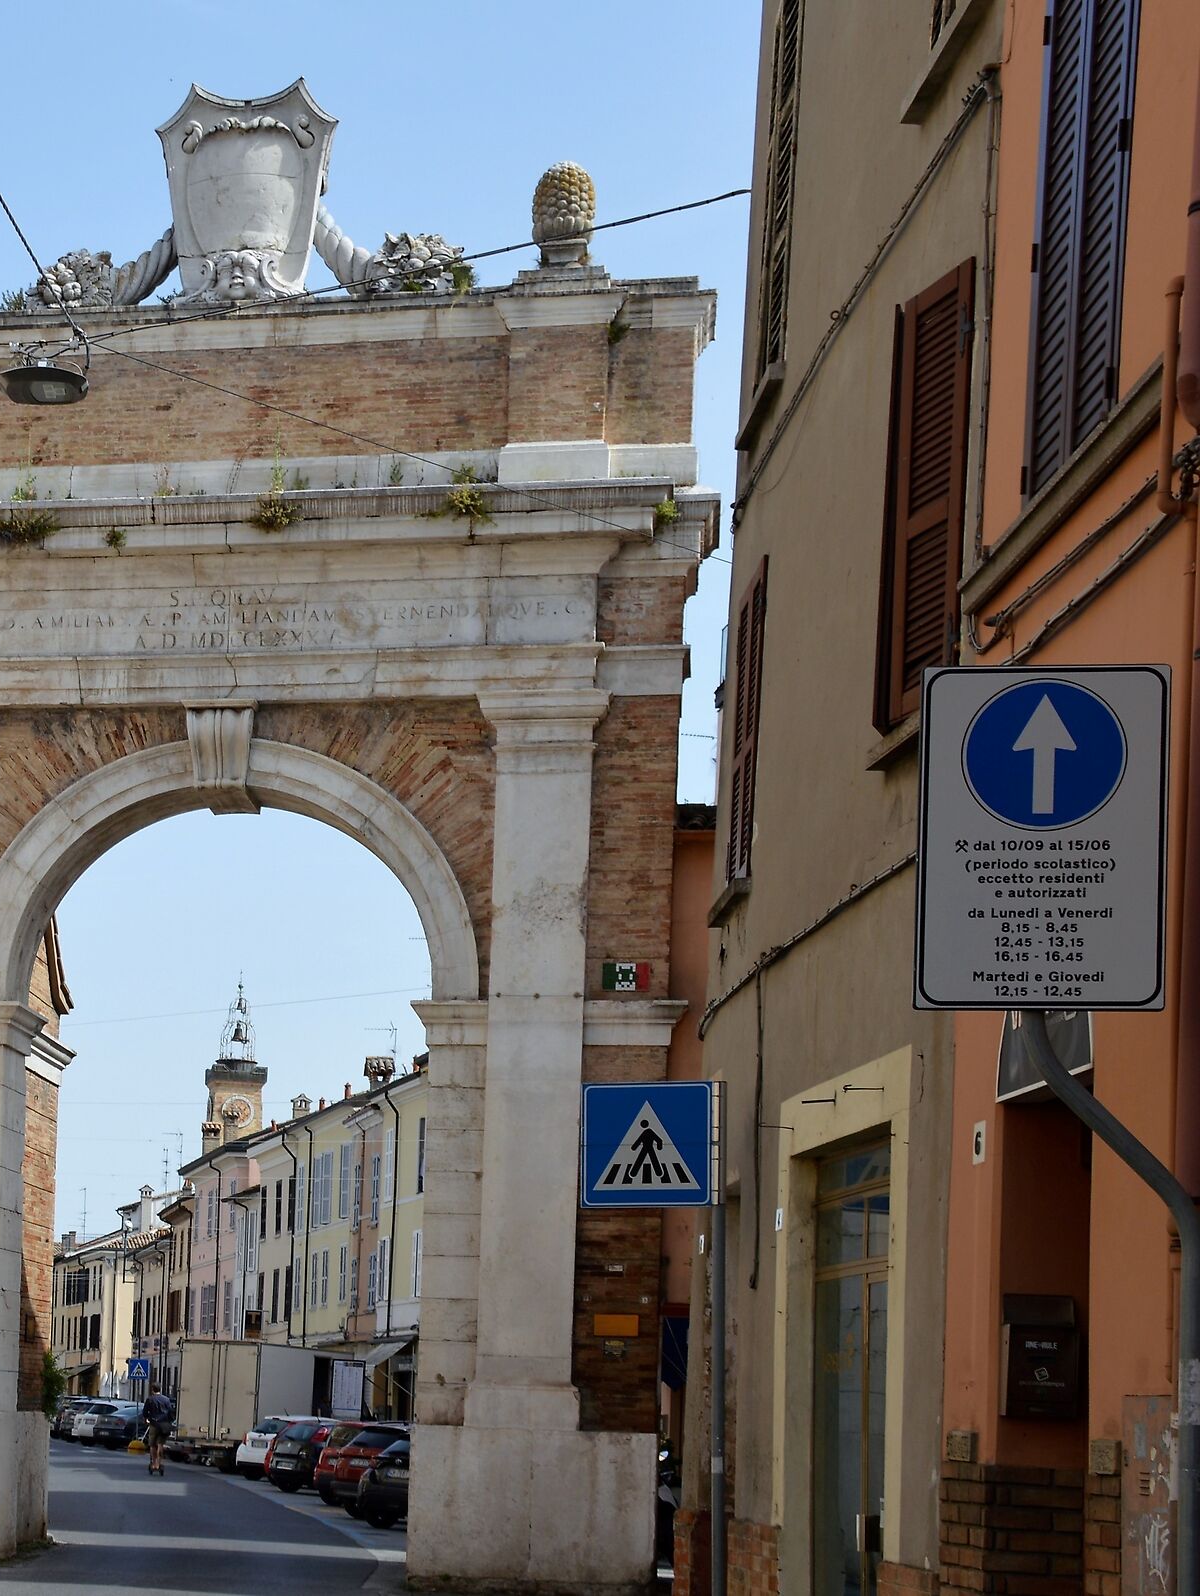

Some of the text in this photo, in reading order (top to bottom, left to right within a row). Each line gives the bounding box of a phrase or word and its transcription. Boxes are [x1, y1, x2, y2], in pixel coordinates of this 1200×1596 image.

[974, 840, 1110, 851] dal 10/09 al 15/06
[965, 858, 1116, 872] (periodo scolastico)
[978, 873, 1104, 883] eccetto residenti
[995, 887, 1086, 898] e autorizzati
[968, 908, 1112, 918] da Lunedi a Venerdi
[973, 971, 1104, 982] Martedi e Giovedi
[974, 1131, 982, 1156] 6
